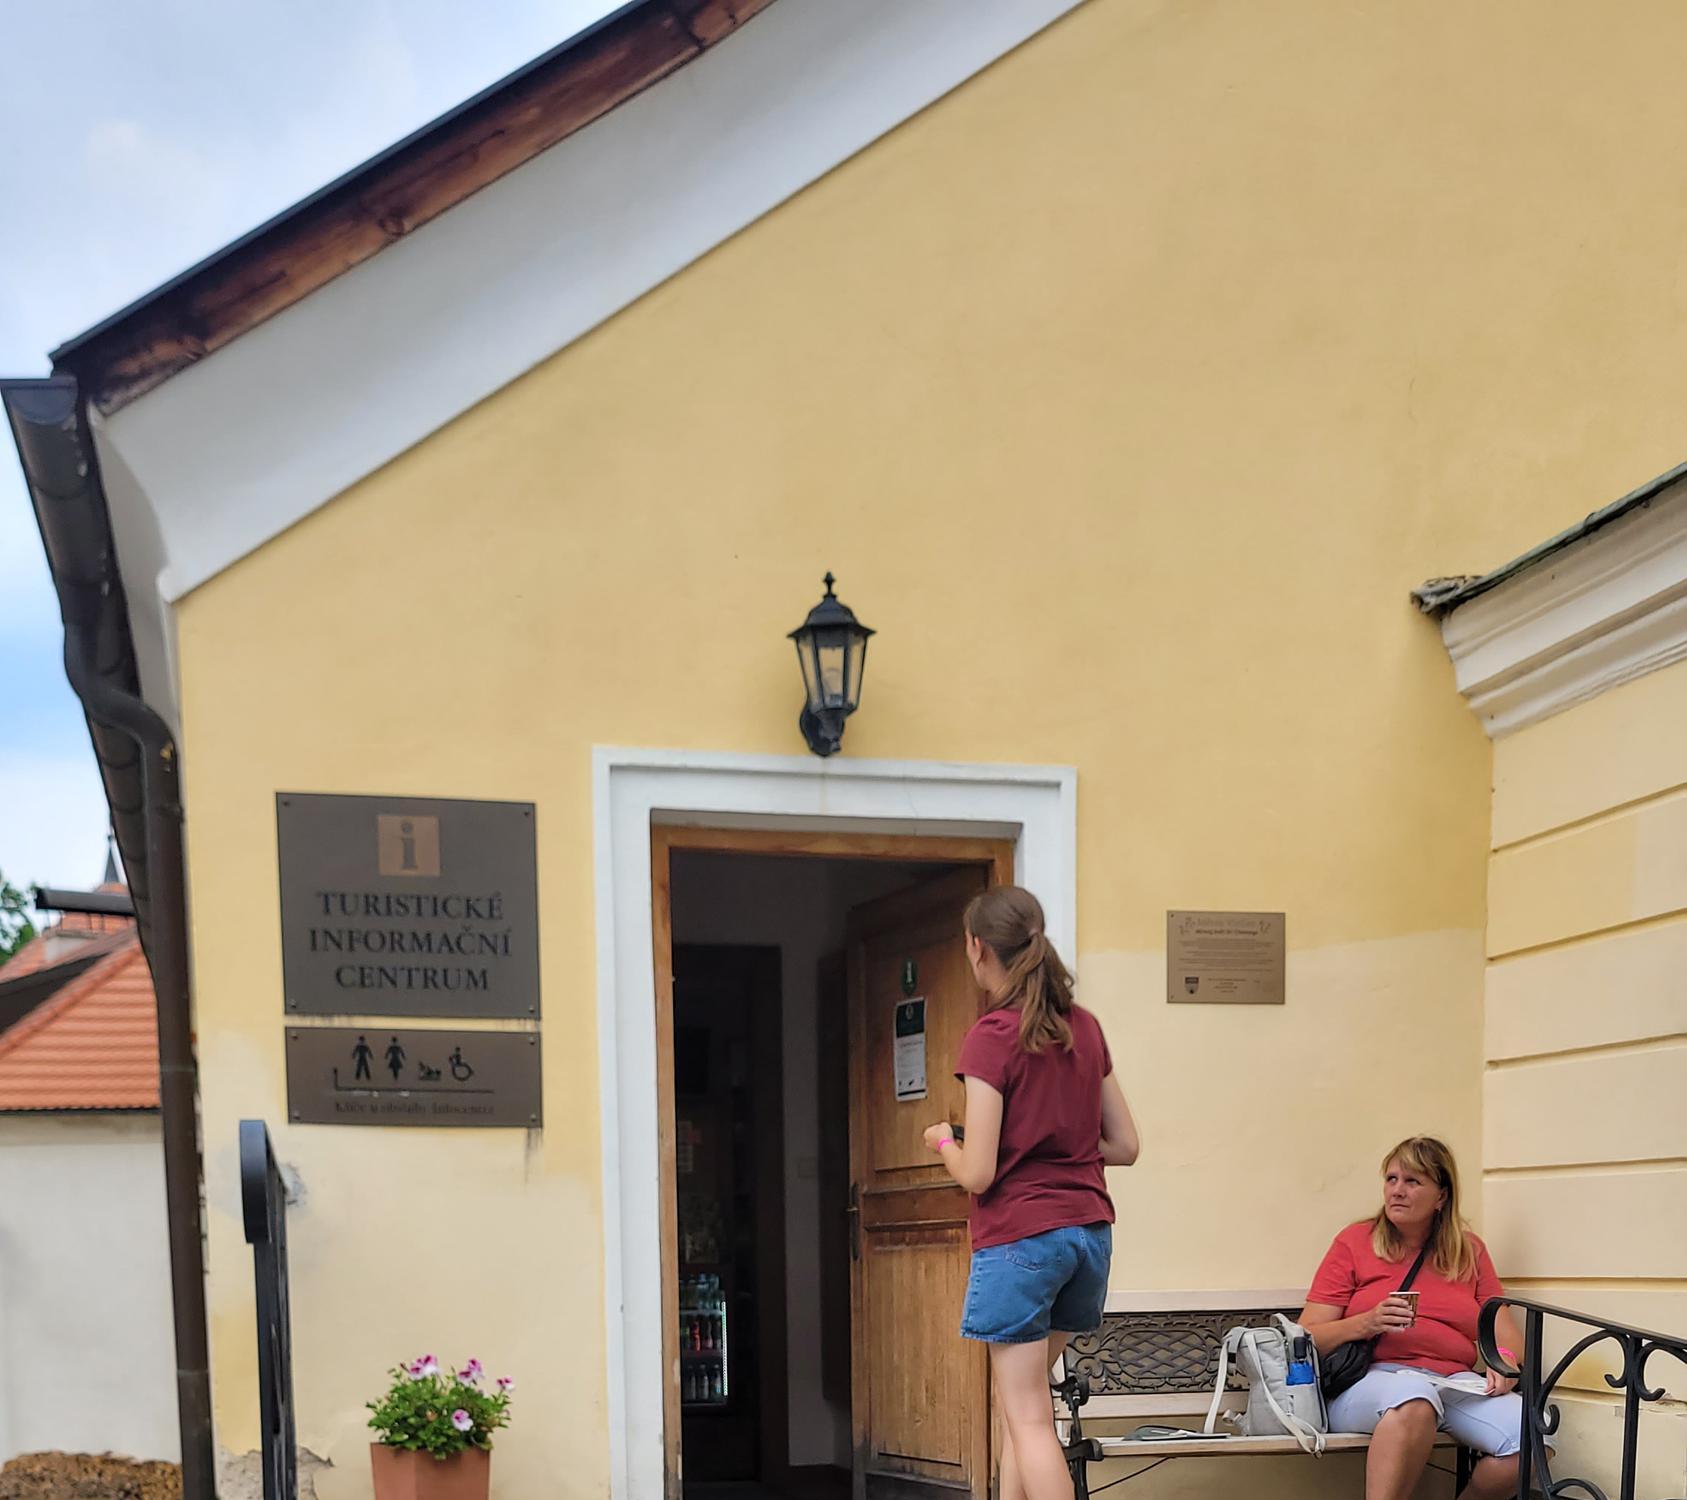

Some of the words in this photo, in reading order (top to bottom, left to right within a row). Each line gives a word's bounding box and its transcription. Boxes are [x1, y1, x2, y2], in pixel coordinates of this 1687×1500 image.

[316, 891, 503, 920] TURISTICKÉ
[309, 925, 512, 957] INFORMAČNÍ
[335, 965, 490, 991] CENTRUM
